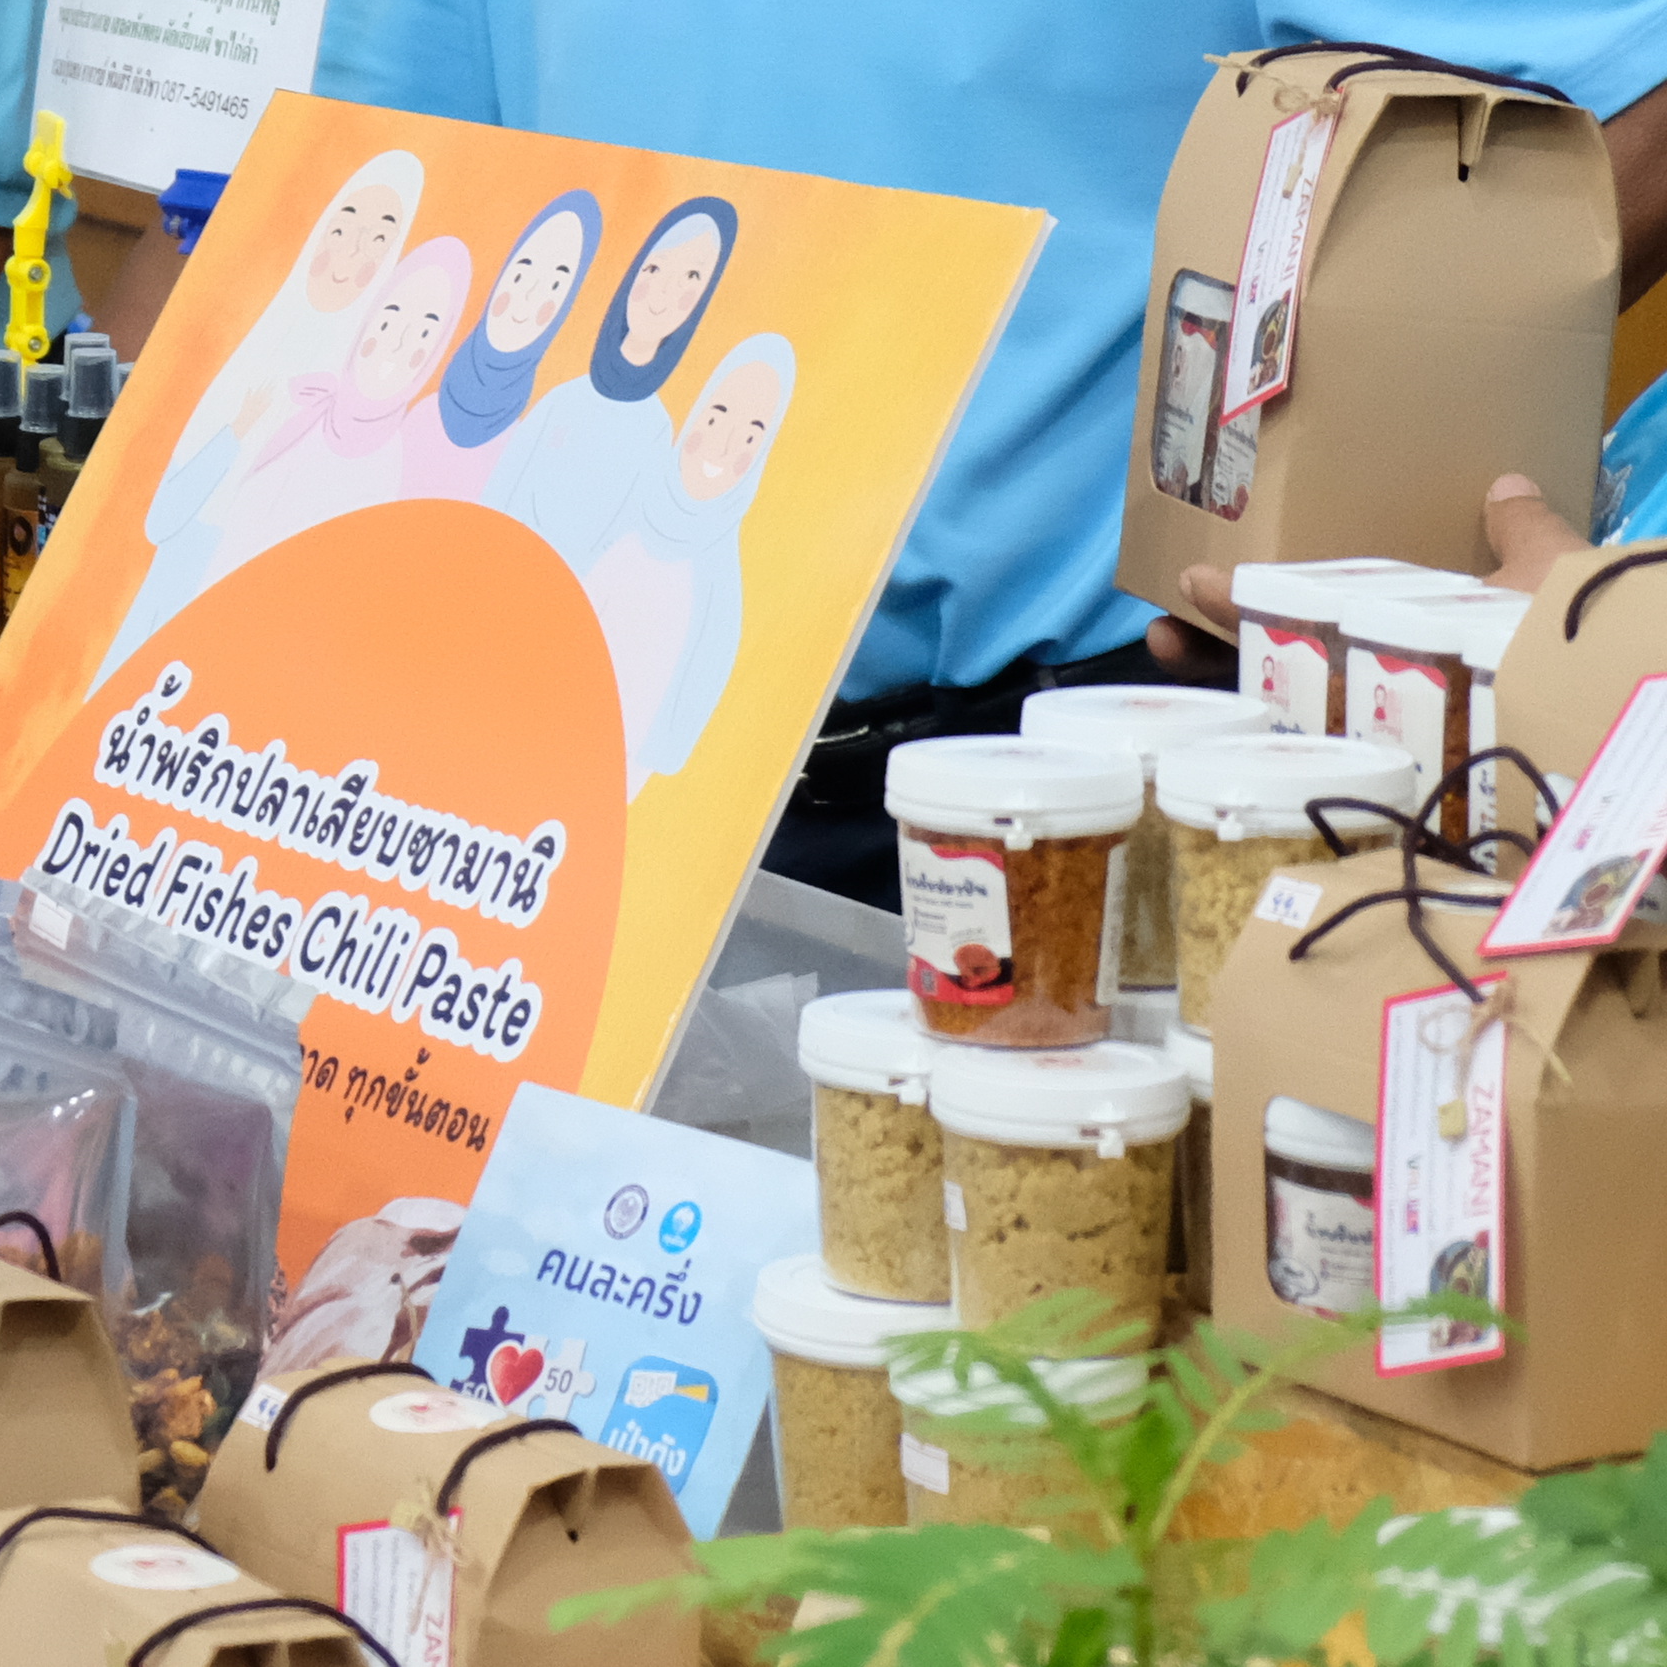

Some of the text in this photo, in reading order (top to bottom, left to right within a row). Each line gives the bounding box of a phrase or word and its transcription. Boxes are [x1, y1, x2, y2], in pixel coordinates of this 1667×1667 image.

[214, 30, 259, 65] ขาไก่ดำ
[160, 79, 250, 121] 087-5491465
[42, 812, 535, 1048] Dried Fishes Chili Paste
[343, 1047, 491, 1152] ทุกขั้นตอน
[1469, 1083, 1495, 1218] ZAMANI
[536, 1247, 703, 1326] คนละครึ่ง
[544, 1367, 574, 1393] 50
